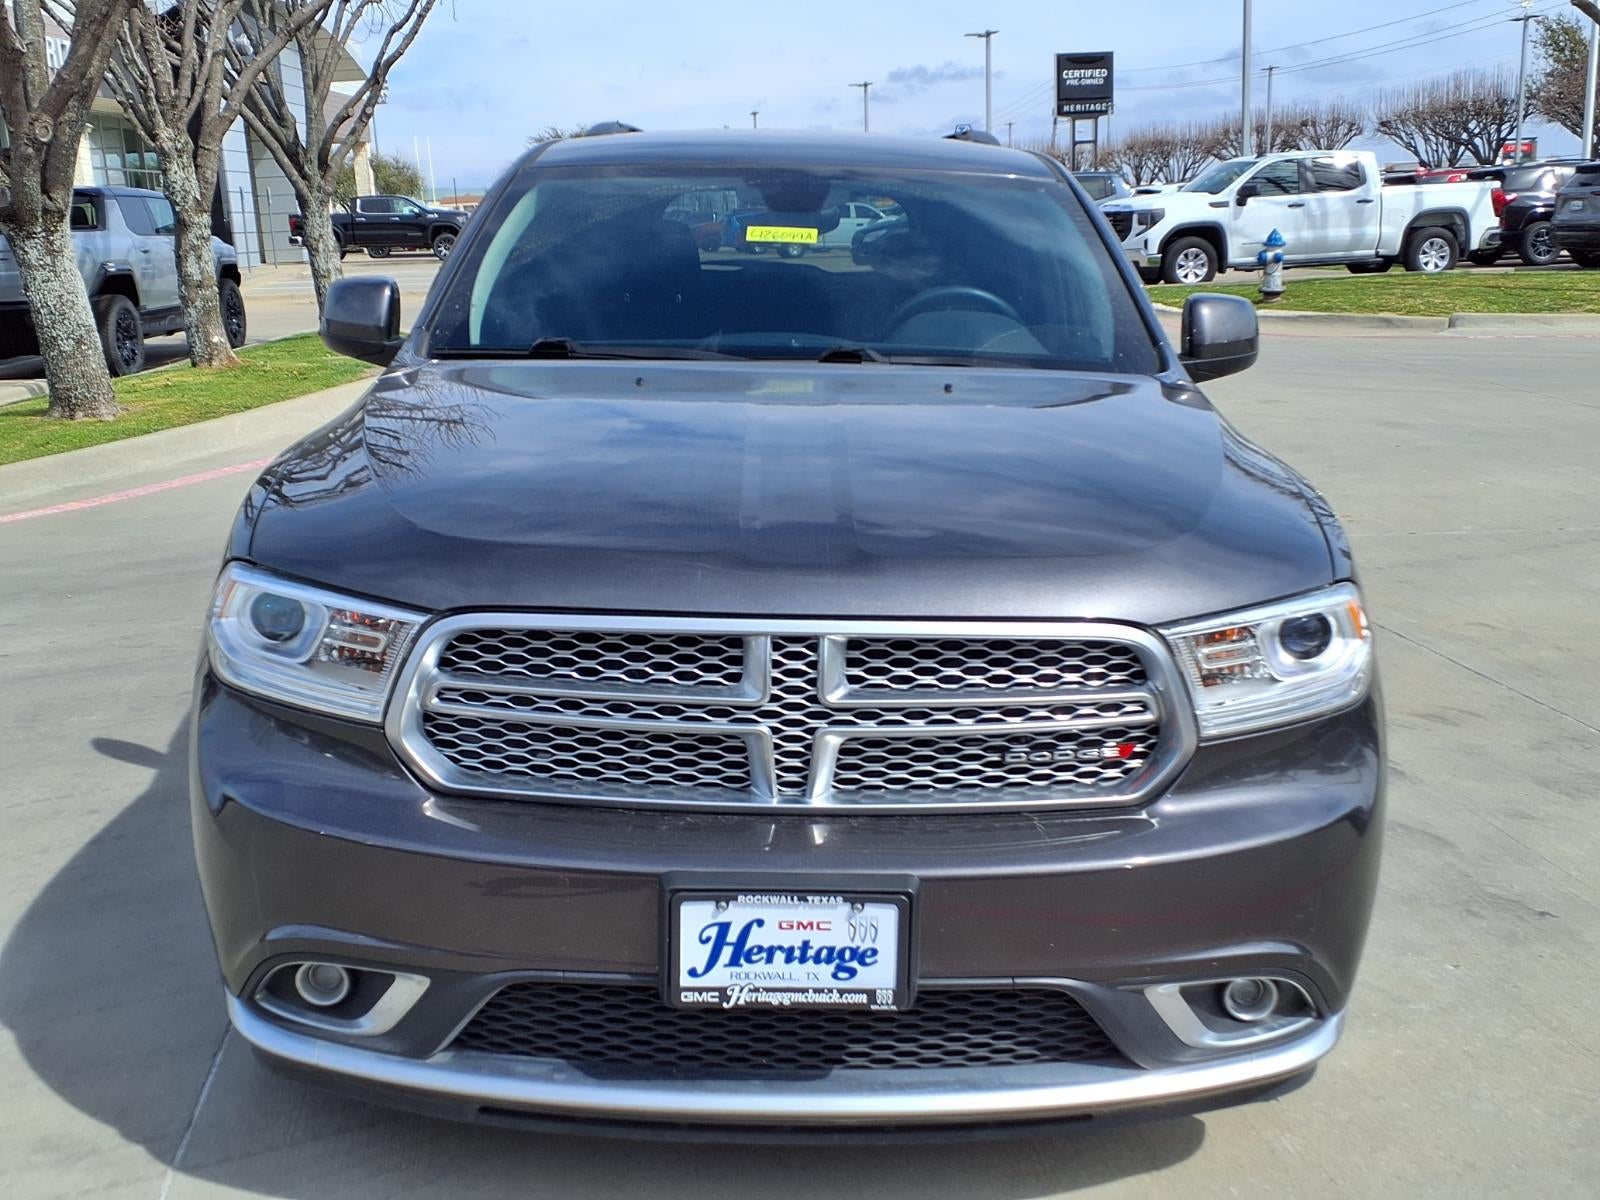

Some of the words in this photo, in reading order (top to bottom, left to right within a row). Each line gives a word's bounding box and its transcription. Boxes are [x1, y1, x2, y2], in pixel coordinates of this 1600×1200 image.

[1063, 69, 1108, 78] CERTIFIED
[1063, 103, 1107, 112] HERITAGE
[806, 895, 845, 905] TEXAS
[778, 920, 832, 931] GMC
[687, 918, 879, 981] Heritage
[804, 971, 820, 981] TX
[680, 991, 720, 1003] GMC
[722, 982, 868, 1008] Heritagegmcbuick.com
